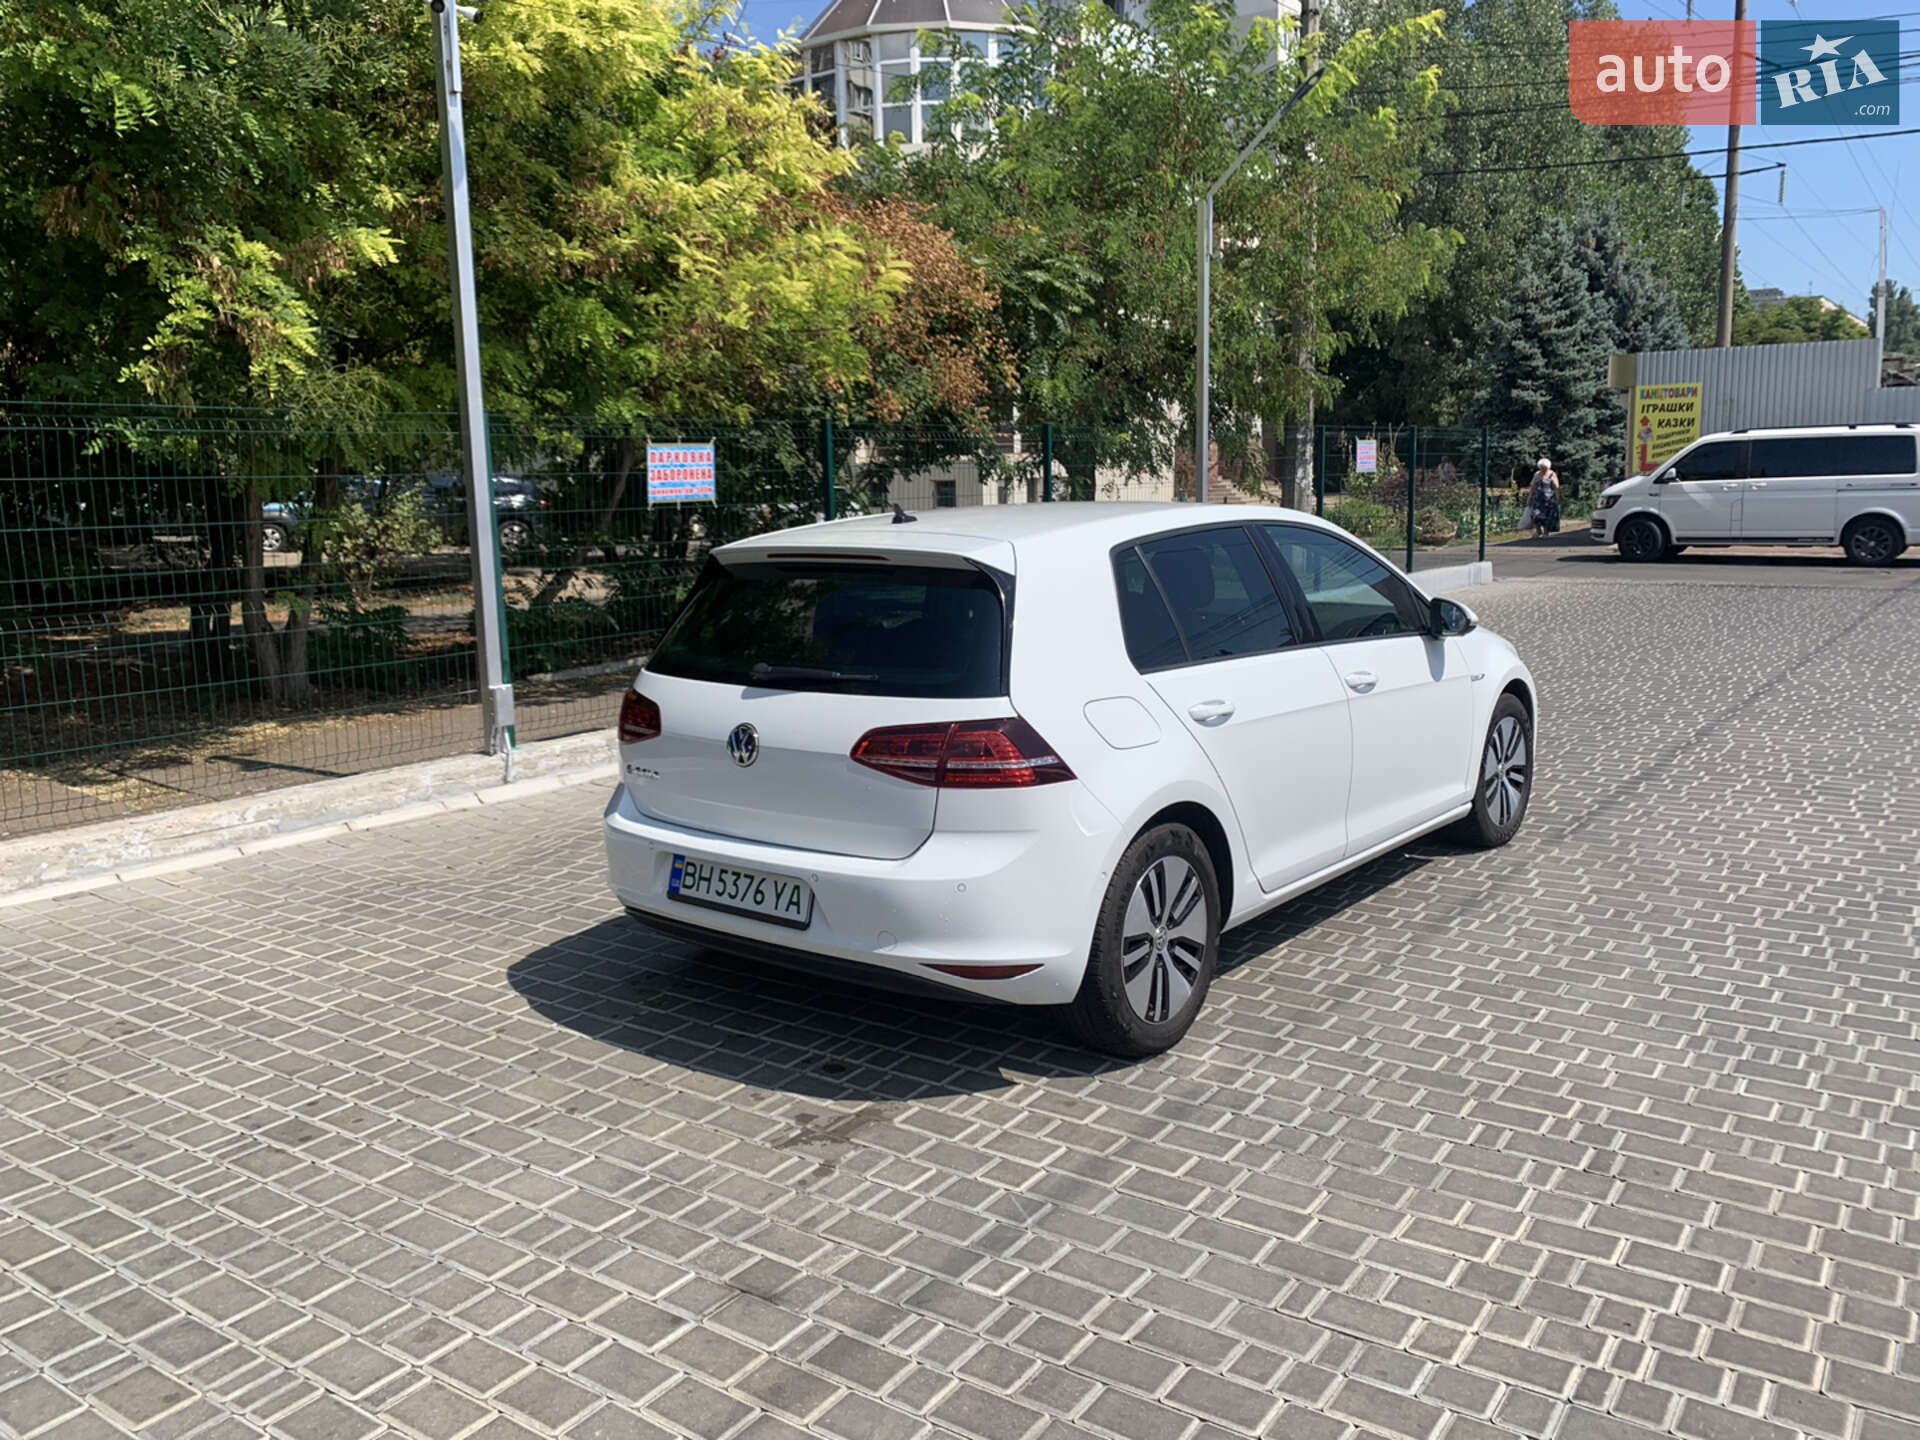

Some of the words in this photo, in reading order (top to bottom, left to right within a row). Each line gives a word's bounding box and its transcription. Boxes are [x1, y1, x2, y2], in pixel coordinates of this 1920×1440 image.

[1640, 386, 1699, 400] КАНЦТОВАРИ
[1641, 402, 1694, 414] ІГРАШКИ
[1657, 418, 1695, 428] КАЗКИ
[650, 451, 713, 465] ПАРКОВКА
[650, 468, 713, 482] ЗАБОРОНЕНА
[682, 861, 714, 894] BH
[715, 868, 766, 905] 5376
[774, 880, 801, 914] YA
